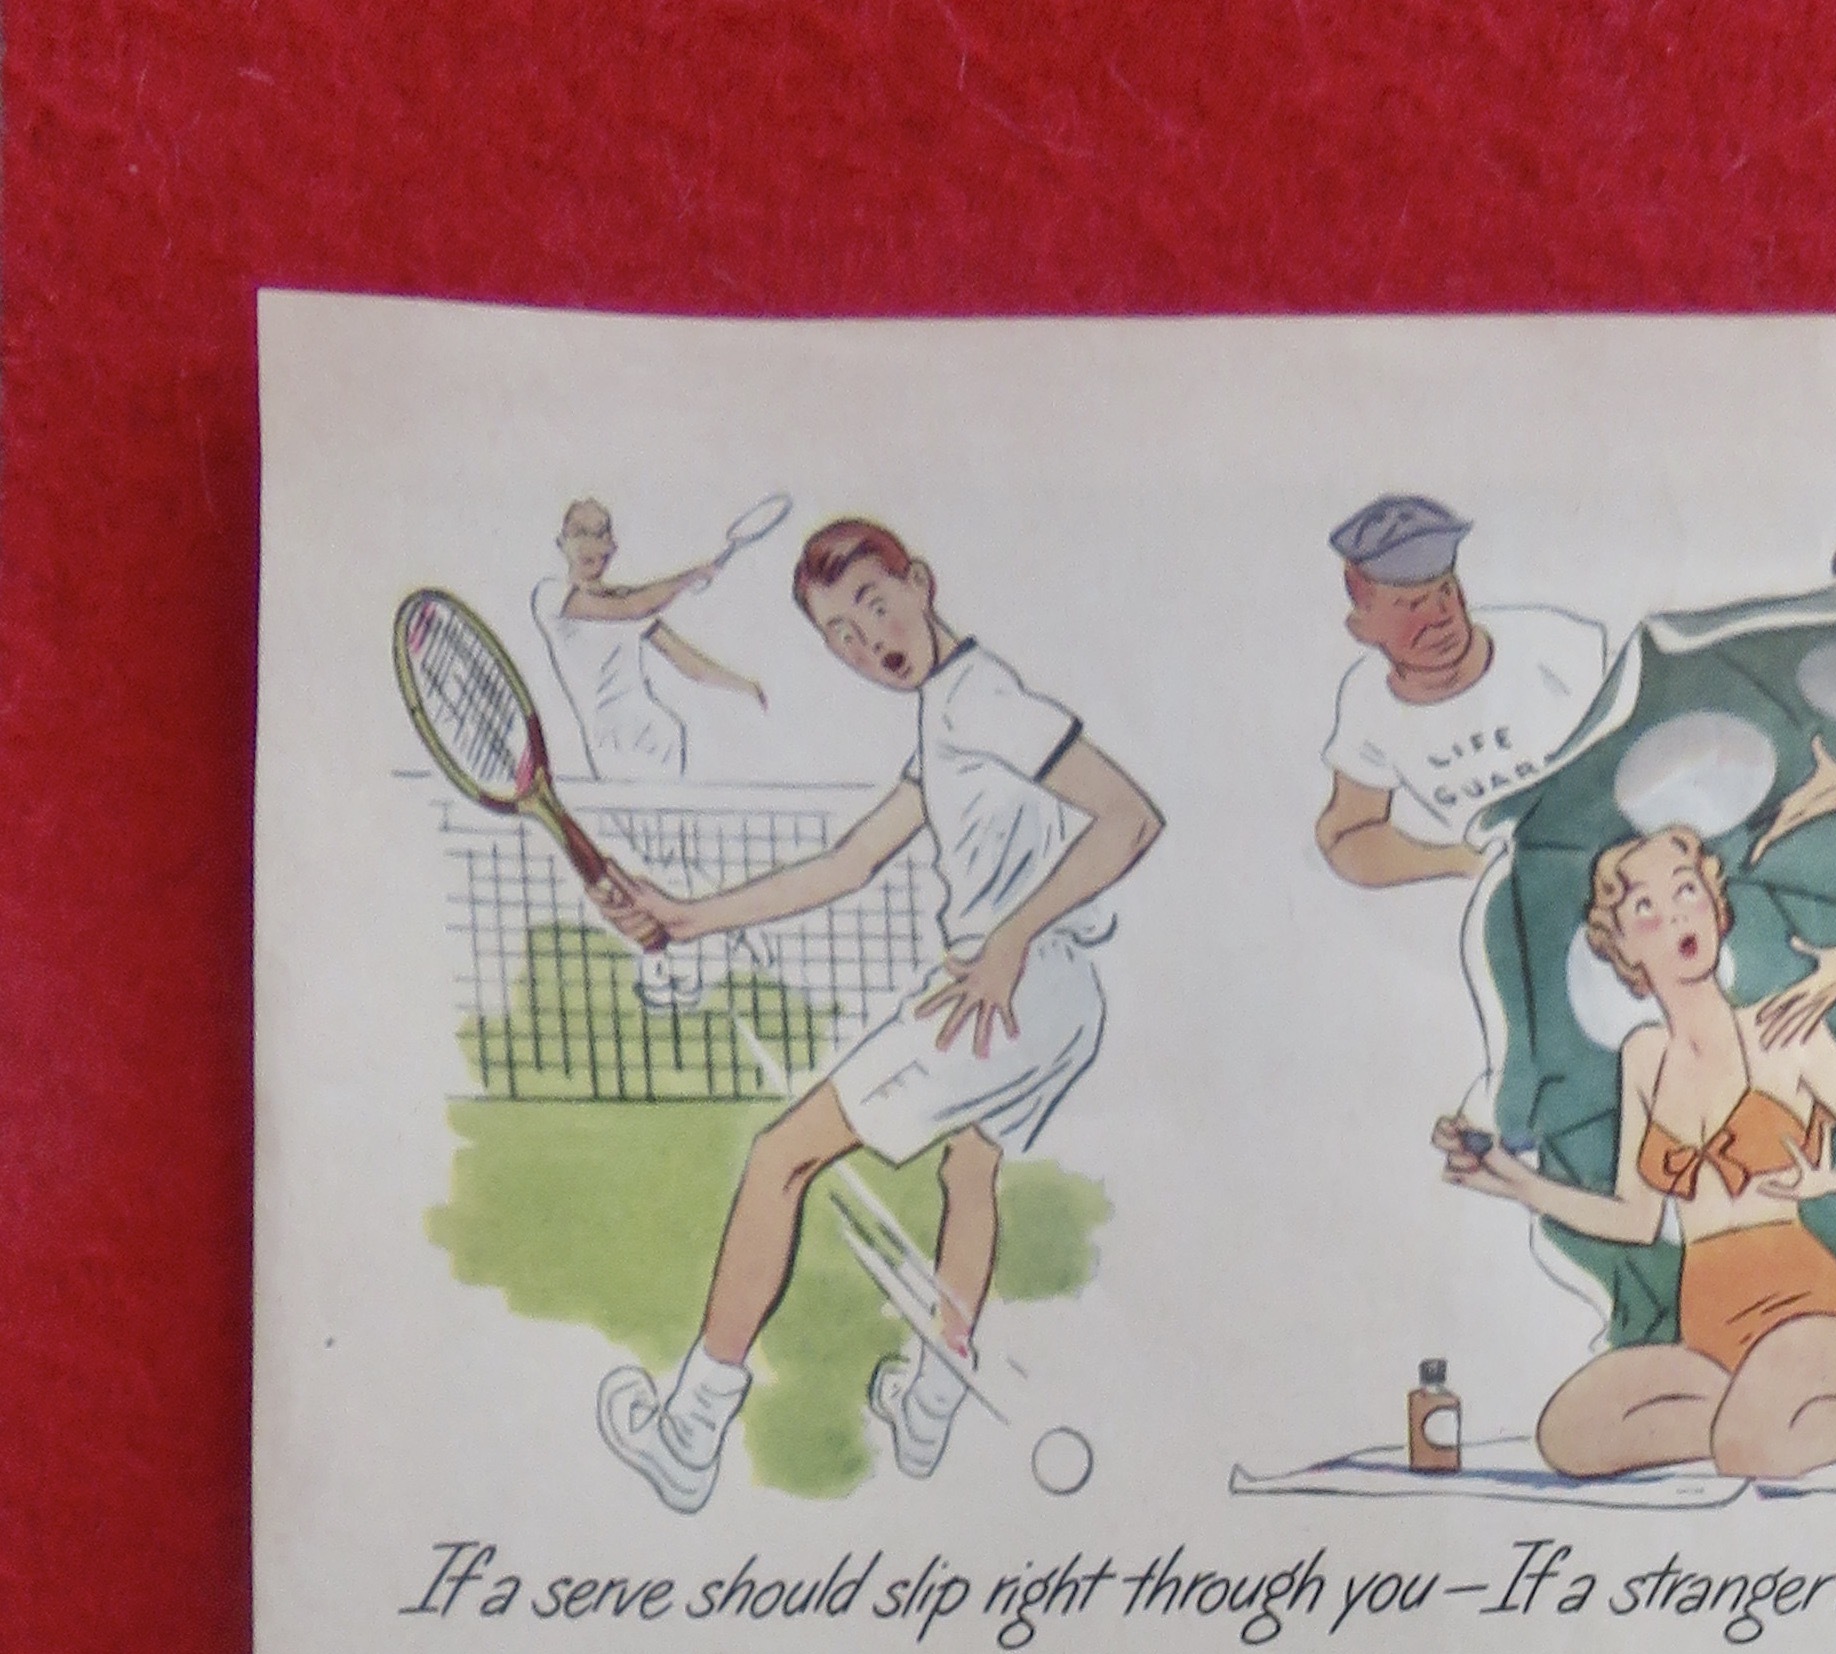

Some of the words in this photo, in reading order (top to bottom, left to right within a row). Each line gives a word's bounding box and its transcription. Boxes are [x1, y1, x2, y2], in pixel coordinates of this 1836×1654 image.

[1427, 727, 1512, 767] LIFE
[398, 1540, 497, 1617] If
[480, 1574, 522, 1617] a
[531, 1576, 675, 1621] serve
[685, 1549, 884, 1619] should
[872, 1553, 971, 1643] slip
[983, 1551, 1117, 1652] right
[1122, 1543, 1327, 1647] through
[1557, 1573, 1597, 1615] a
